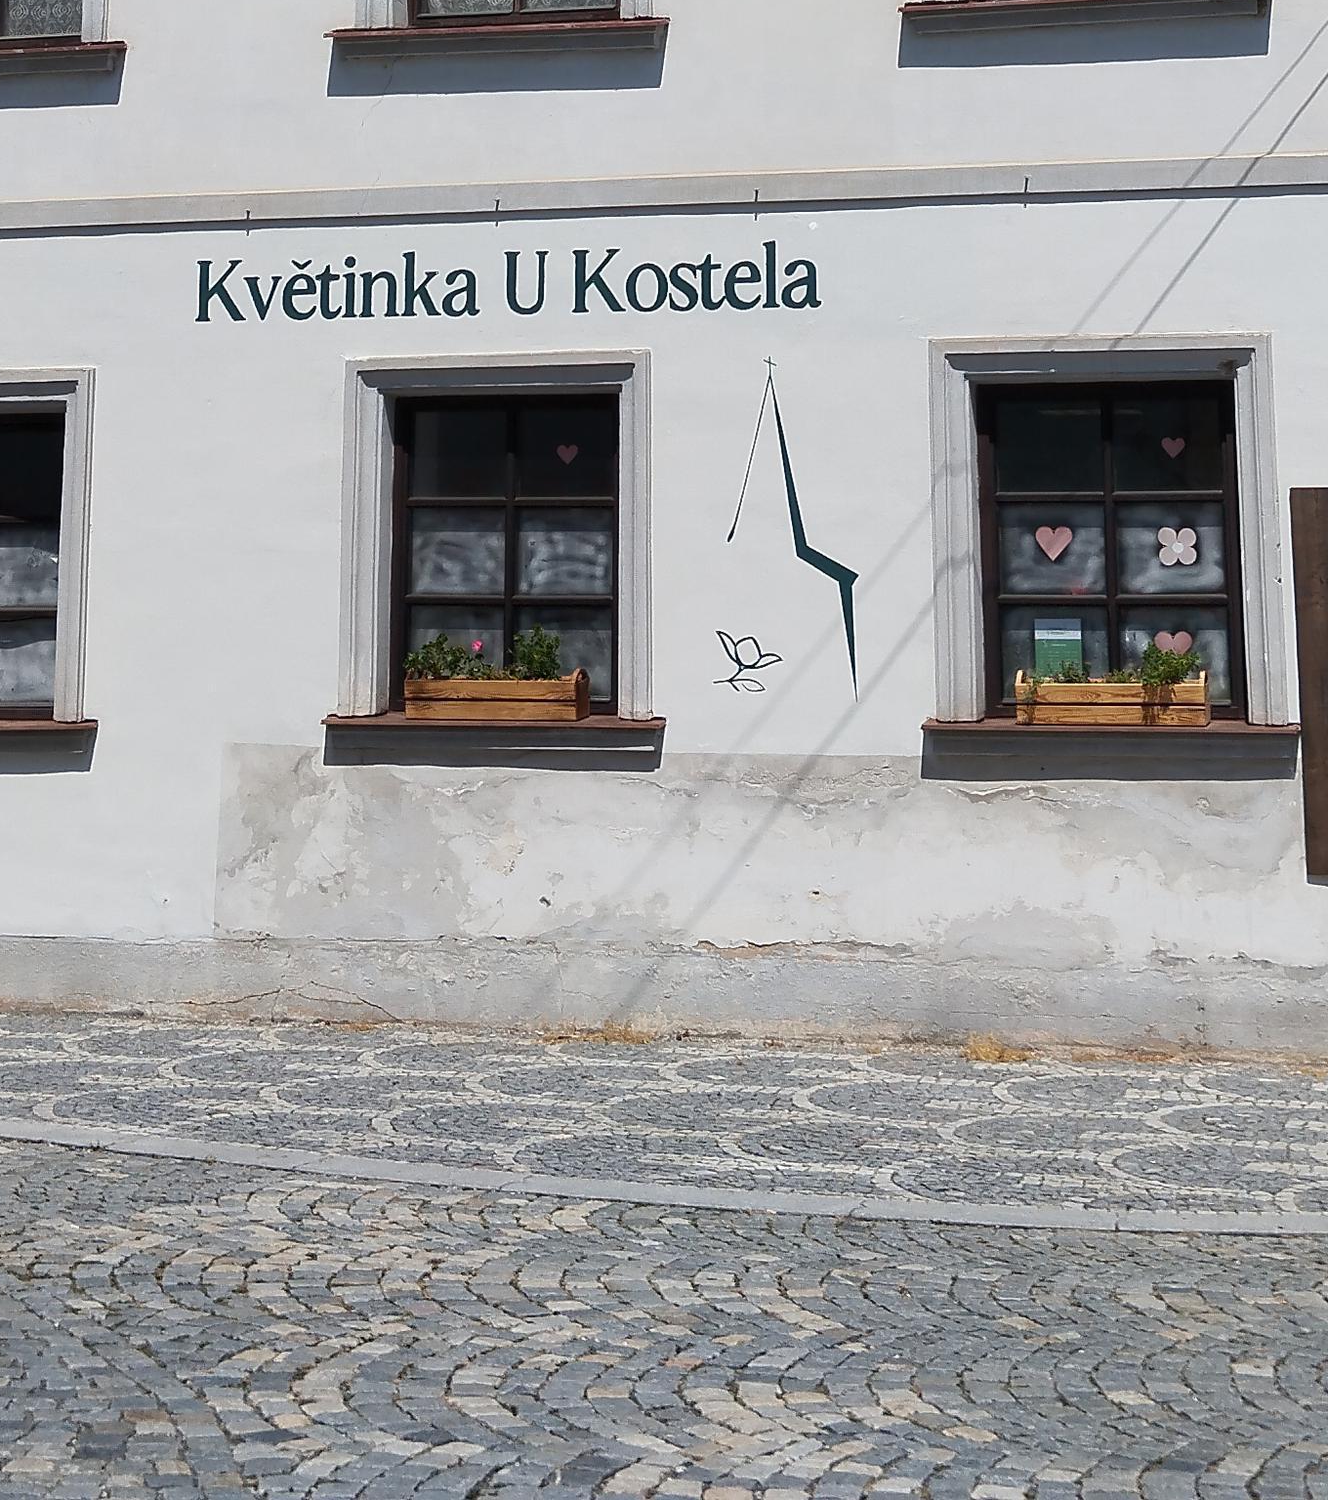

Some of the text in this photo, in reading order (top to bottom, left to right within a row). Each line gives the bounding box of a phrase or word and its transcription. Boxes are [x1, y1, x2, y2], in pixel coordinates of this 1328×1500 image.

[194, 240, 823, 322] Květinka U Kostela
